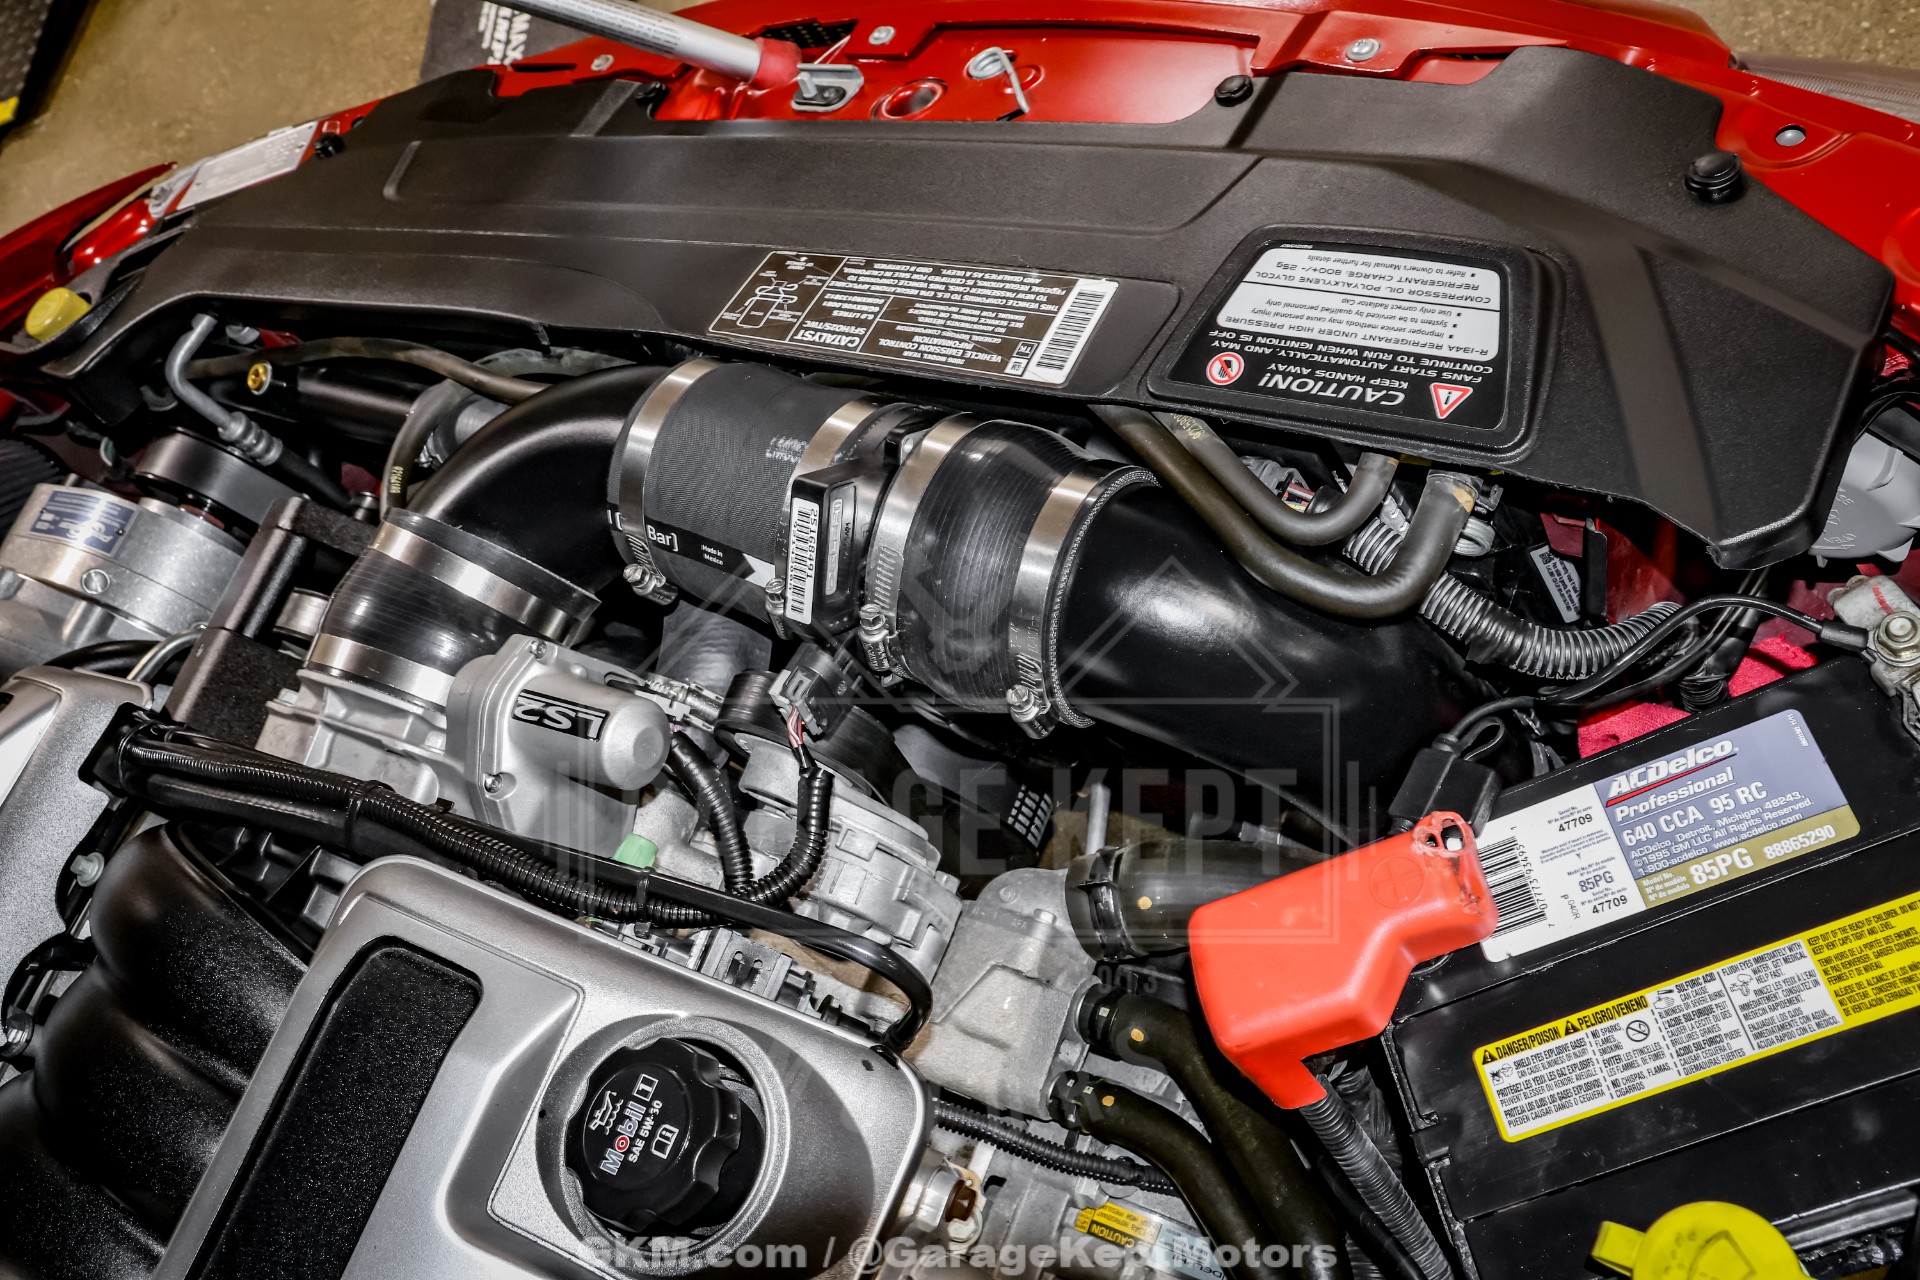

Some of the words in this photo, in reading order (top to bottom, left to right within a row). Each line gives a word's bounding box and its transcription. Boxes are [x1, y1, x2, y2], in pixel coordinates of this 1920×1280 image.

[1307, 254, 1331, 262] details
[1332, 258, 1358, 266] further
[1276, 261, 1297, 270] 25g
[1373, 262, 1401, 270] Manual
[1255, 271, 1295, 281] GLYCOL
[1445, 269, 1465, 277] Refer
[1299, 276, 1381, 291] POLYALKYLENE
[1397, 277, 1479, 290] REFRIGERANT
[962, 294, 1006, 304] CONFORMS
[1265, 298, 1282, 306] only
[1341, 297, 1355, 305] Cap
[1408, 289, 1490, 303] COMPRESSOR
[1005, 299, 1039, 308] VEHICLE
[1039, 303, 1058, 311] THIS
[1282, 302, 1319, 310] personnel
[1356, 300, 1389, 309] Radiator
[831, 309, 861, 318] LITRES
[1251, 307, 1271, 315] injury
[1272, 311, 1305, 320] personal
[1320, 306, 1353, 314] qualified
[1365, 312, 1396, 320] serviced
[1419, 306, 1436, 314] only
[1225, 316, 1284, 329] PRESSURE
[1288, 324, 1314, 332] HIGH
[1345, 320, 1378, 329] methods
[1420, 318, 1448, 327] System
[793, 329, 859, 347] CATALYST
[1208, 330, 1236, 338] OFF
[1318, 328, 1357, 338] UNDER
[1407, 328, 1444, 338] Improper
[878, 338, 918, 349] CONTROL
[912, 335, 975, 349] INFORMATION
[1211, 340, 1241, 349] MAY
[1256, 336, 1313, 349] IGNITION
[1361, 334, 1443, 350] REFRIGERANT
[918, 344, 963, 356] EMISSION
[1243, 345, 1273, 354] AND
[1316, 344, 1358, 356] WHEN
[1362, 350, 1393, 360] RUN
[1448, 344, 1488, 355] R-134A
[922, 353, 947, 361] MODEL
[963, 350, 1001, 362] VEHICLE
[1396, 355, 1415, 363] TO
[1267, 363, 1311, 374] AWAY
[1390, 365, 1437, 377] START
[1420, 358, 1493, 373] CONTINUE
[1314, 369, 1365, 382] HANDS
[1441, 371, 1482, 383] FANS
[1259, 373, 1404, 405] CAUTION!
[1369, 377, 1408, 389] KEEP
[514, 695, 604, 739] LS2
[1609, 740, 1735, 796] ACDelco
[1615, 766, 1732, 821] Professional
[1622, 822, 1657, 846] 640
[1659, 805, 1704, 832] CCA
[1709, 793, 1735, 814] 95
[1735, 781, 1766, 804] RC
[1558, 813, 1592, 831] 47709
[1631, 839, 1674, 858] ACDelco,
[1675, 824, 1715, 841] Detroit,
[1716, 807, 1762, 829] Michigan
[1764, 791, 1804, 809] 48243,
[1671, 841, 1690, 853] GM
[1692, 833, 1712, 846] LLC
[1714, 827, 1727, 838] All
[1728, 817, 1762, 833] Rights
[1763, 797, 1814, 820] Reserved.
[1638, 847, 1707, 875] 1-800-acdelco
[1713, 813, 1802, 848] www.acdelco.com
[1763, 825, 1835, 859] 88865290
[1689, 847, 1753, 884] 85PG
[1578, 870, 1614, 892] 85PG
[1641, 874, 1663, 886] Model
[1592, 894, 1627, 913] 47709
[1721, 964, 1739, 976] FLUSH
[1738, 959, 1753, 970] EYES
[1752, 947, 1786, 964] IMMEDIATELY
[1787, 942, 1802, 953] WITH
[1771, 958, 1782, 968] GET
[1782, 951, 1807, 964] MEDICAL
[1675, 976, 1702, 993] SULFURIC
[1701, 972, 1716, 984] ACID
[1755, 972, 1769, 984] HELP
[1679, 992, 1691, 1002] CAN
[1690, 985, 1709, 998] CAUSE
[1577, 995, 1647, 1029] PELIGRO/VENENO
[1590, 1029, 1600, 1039] NO
[1495, 1026, 1561, 1058] DANGER/POISON
[1513, 1056, 1531, 1070] SHIELD
[1530, 1052, 1544, 1064] EYES
[1543, 1042, 1570, 1059] EXPLOSIVE
[1569, 1037, 1586, 1050] GASES
[1598, 1041, 1623, 1056] SMOKING
[1615, 1081, 1645, 1098] CIGARROS
[600, 1101, 647, 1176] Mobil
[629, 1138, 645, 1164] SAE
[1091, 1223, 1136, 1249] CAUTION
